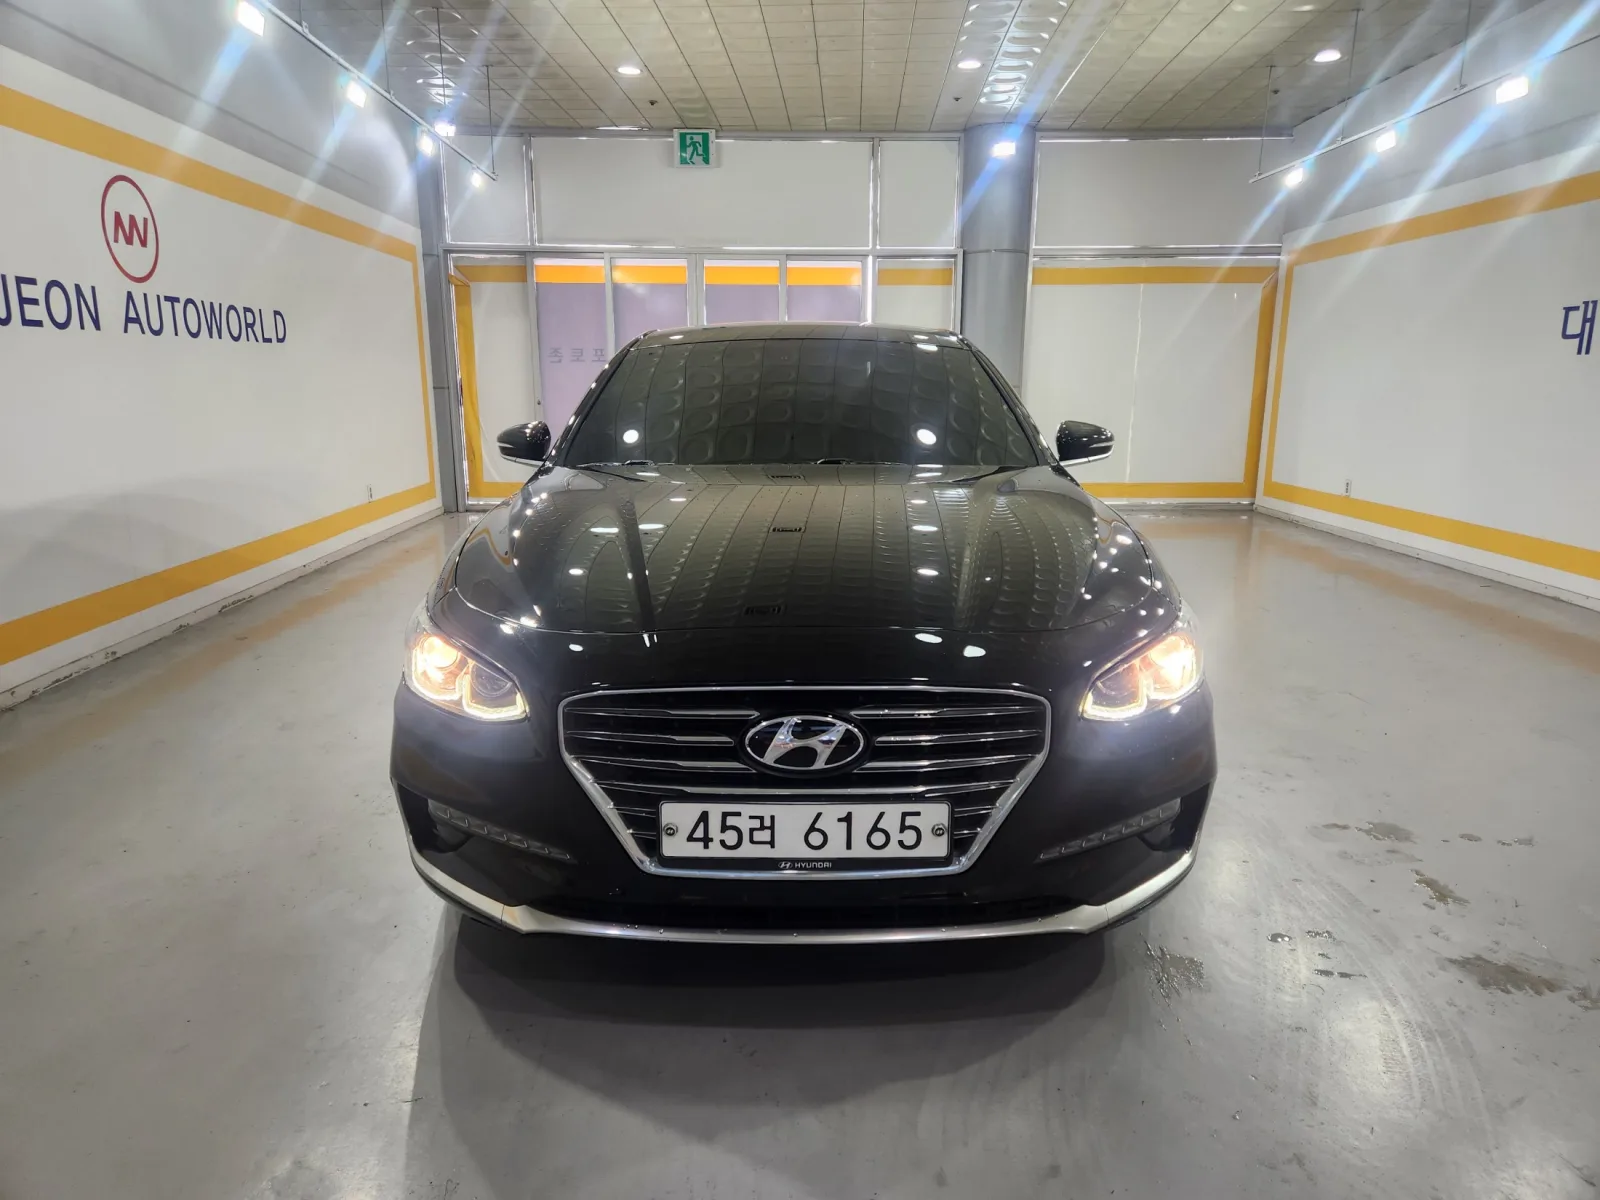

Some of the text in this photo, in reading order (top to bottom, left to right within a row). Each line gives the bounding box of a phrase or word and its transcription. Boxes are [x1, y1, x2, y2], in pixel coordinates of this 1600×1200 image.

[123, 290, 287, 344] AUTOWORLD
[1561, 300, 1598, 355] 대
[686, 810, 922, 851] 45러 6165
[794, 861, 832, 869] HYUNDAI
